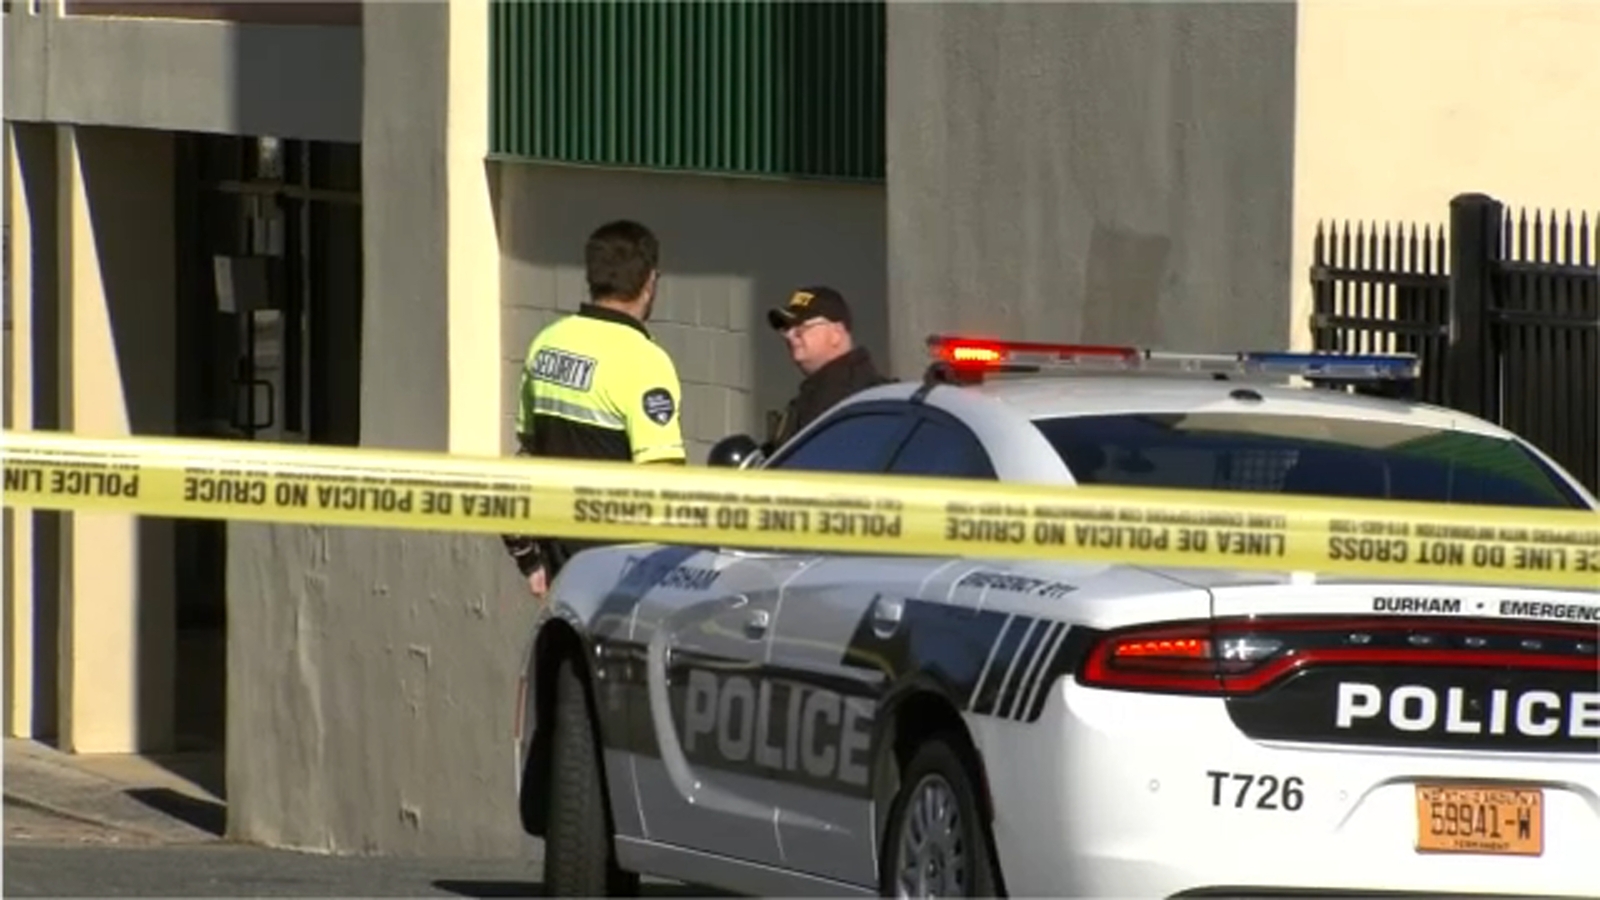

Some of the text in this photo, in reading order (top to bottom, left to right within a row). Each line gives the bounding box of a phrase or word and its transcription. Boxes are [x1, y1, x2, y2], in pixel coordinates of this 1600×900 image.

[532, 349, 593, 386] SECURITY
[51, 469, 140, 497] POLICE
[184, 476, 267, 505] CRUCE
[275, 482, 308, 507] NO
[317, 485, 413, 513] POLICIA
[421, 490, 452, 515] DE
[461, 493, 531, 519] LINEA
[574, 498, 902, 537] POLICE LINE DO NOT CROSS
[945, 516, 1286, 558] LINEA DE POLICIA NO CRUCE
[1329, 536, 1409, 563] CROSS
[1416, 541, 1465, 566] NOT
[1472, 544, 1504, 568] DO
[1514, 547, 1566, 571] LINE
[1373, 597, 1461, 613] DURHAM
[1336, 681, 1600, 737] POLICE
[684, 668, 876, 786] POLICE
[1206, 770, 1304, 811] T726
[1431, 801, 1531, 840] 59941-W
